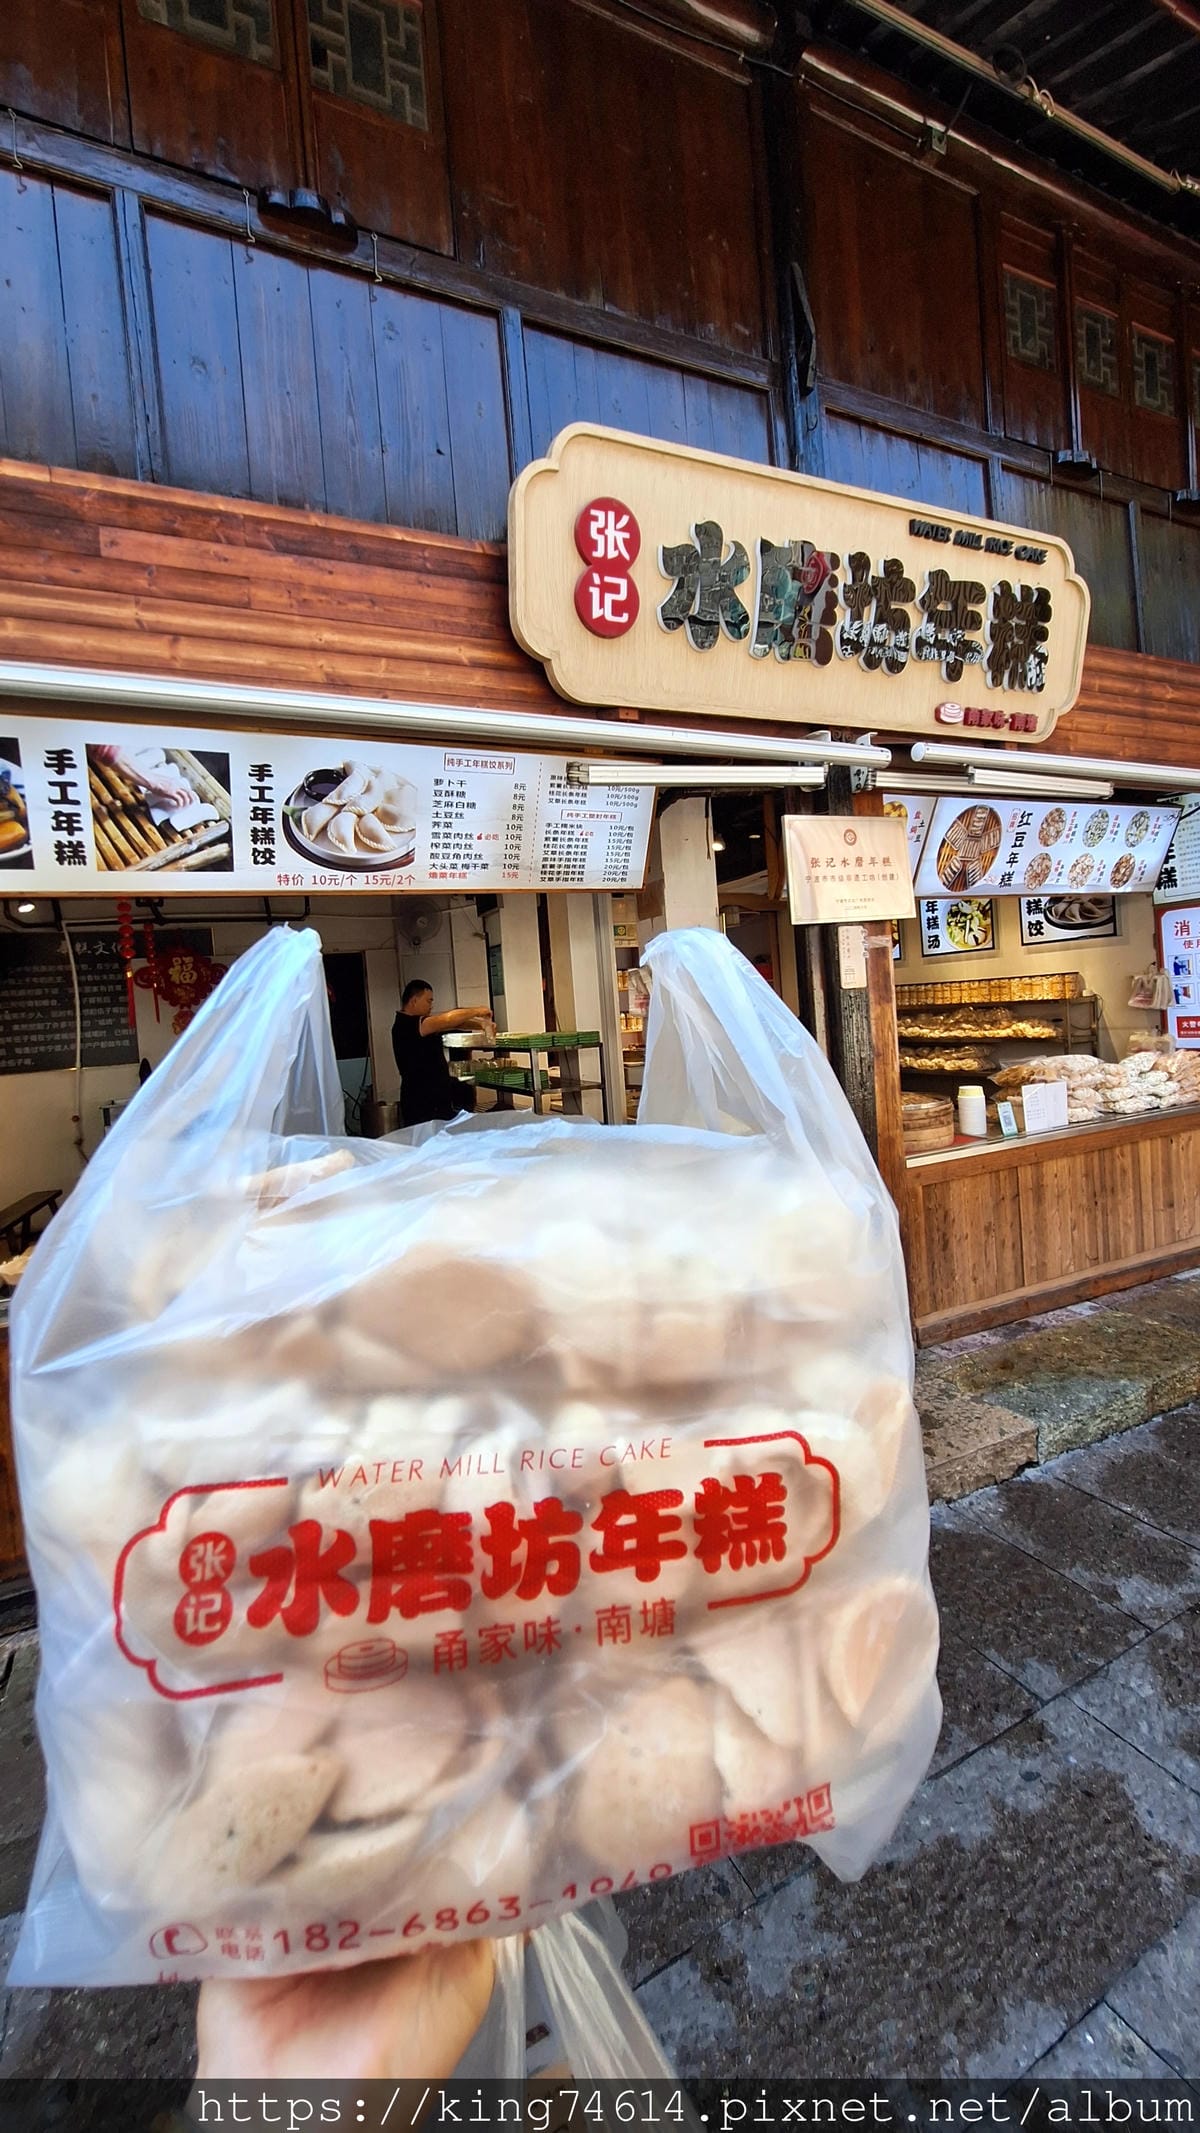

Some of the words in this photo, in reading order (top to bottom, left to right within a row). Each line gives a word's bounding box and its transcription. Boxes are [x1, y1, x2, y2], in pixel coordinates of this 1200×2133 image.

[909, 519, 952, 543] WATER
[953, 529, 984, 550] MILL
[984, 536, 1014, 556] RICE
[1014, 545, 1048, 565] CAKE
[589, 509, 630, 623] 张记
[657, 520, 1050, 693] 水磨坊年糕
[446, 757, 513, 771] 纯手工年糕饺系列
[513, 793, 526, 801] 8元
[514, 782, 527, 791] 8元
[44, 748, 87, 866] 手工年糕
[248, 763, 276, 866] 手工年糕饺
[431, 800, 476, 809] 芝麻白糖
[512, 803, 525, 812] 8元
[431, 811, 465, 819] 土豆丝
[511, 813, 524, 822] 8元
[505, 833, 522, 842] 10元
[506, 823, 524, 832] 10元
[504, 844, 521, 852] 10元
[998, 810, 1034, 888] 红豆年糕
[277, 873, 304, 886] 特价
[311, 873, 358, 887] 10元/个
[364, 874, 416, 887] 15元/2个
[502, 872, 519, 880] 15元
[925, 901, 941, 949] 年糕汤
[168, 956, 198, 985] 福
[317, 1458, 424, 1491] WATER
[439, 1452, 505, 1480] MILL
[519, 1445, 584, 1472] RICE
[599, 1437, 674, 1468] CAKE
[246, 1473, 788, 1637] 水磨坊年糕
[184, 1540, 228, 1636] 张记
[433, 1598, 678, 1675] 甬家味·南塘
